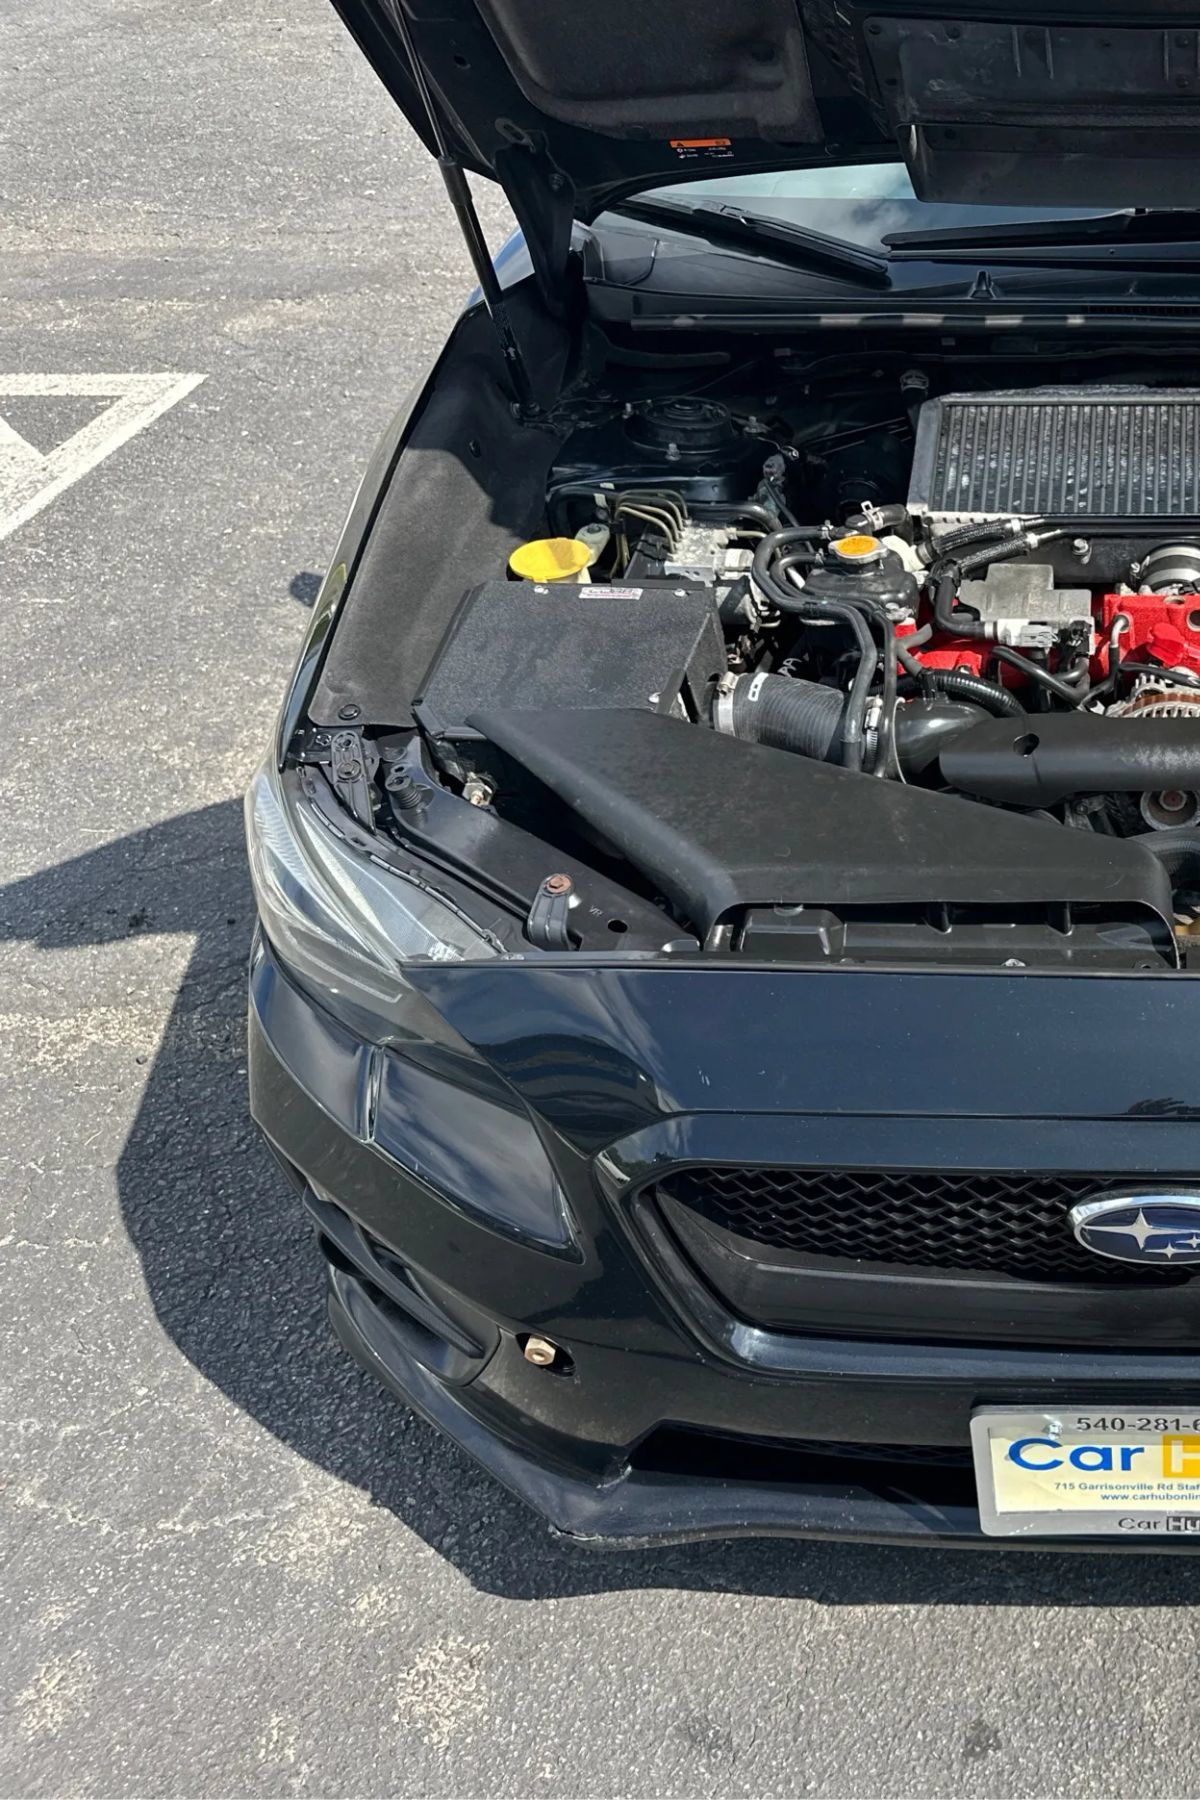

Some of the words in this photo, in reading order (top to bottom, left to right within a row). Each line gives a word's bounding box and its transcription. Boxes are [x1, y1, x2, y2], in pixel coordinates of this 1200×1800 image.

[1008, 1437, 1146, 1472] Car
[1054, 1482, 1076, 1491] 715
[1078, 1482, 1154, 1492] Garrisonville
[1157, 1483, 1174, 1491] Rd
[1118, 1517, 1161, 1530] Car
